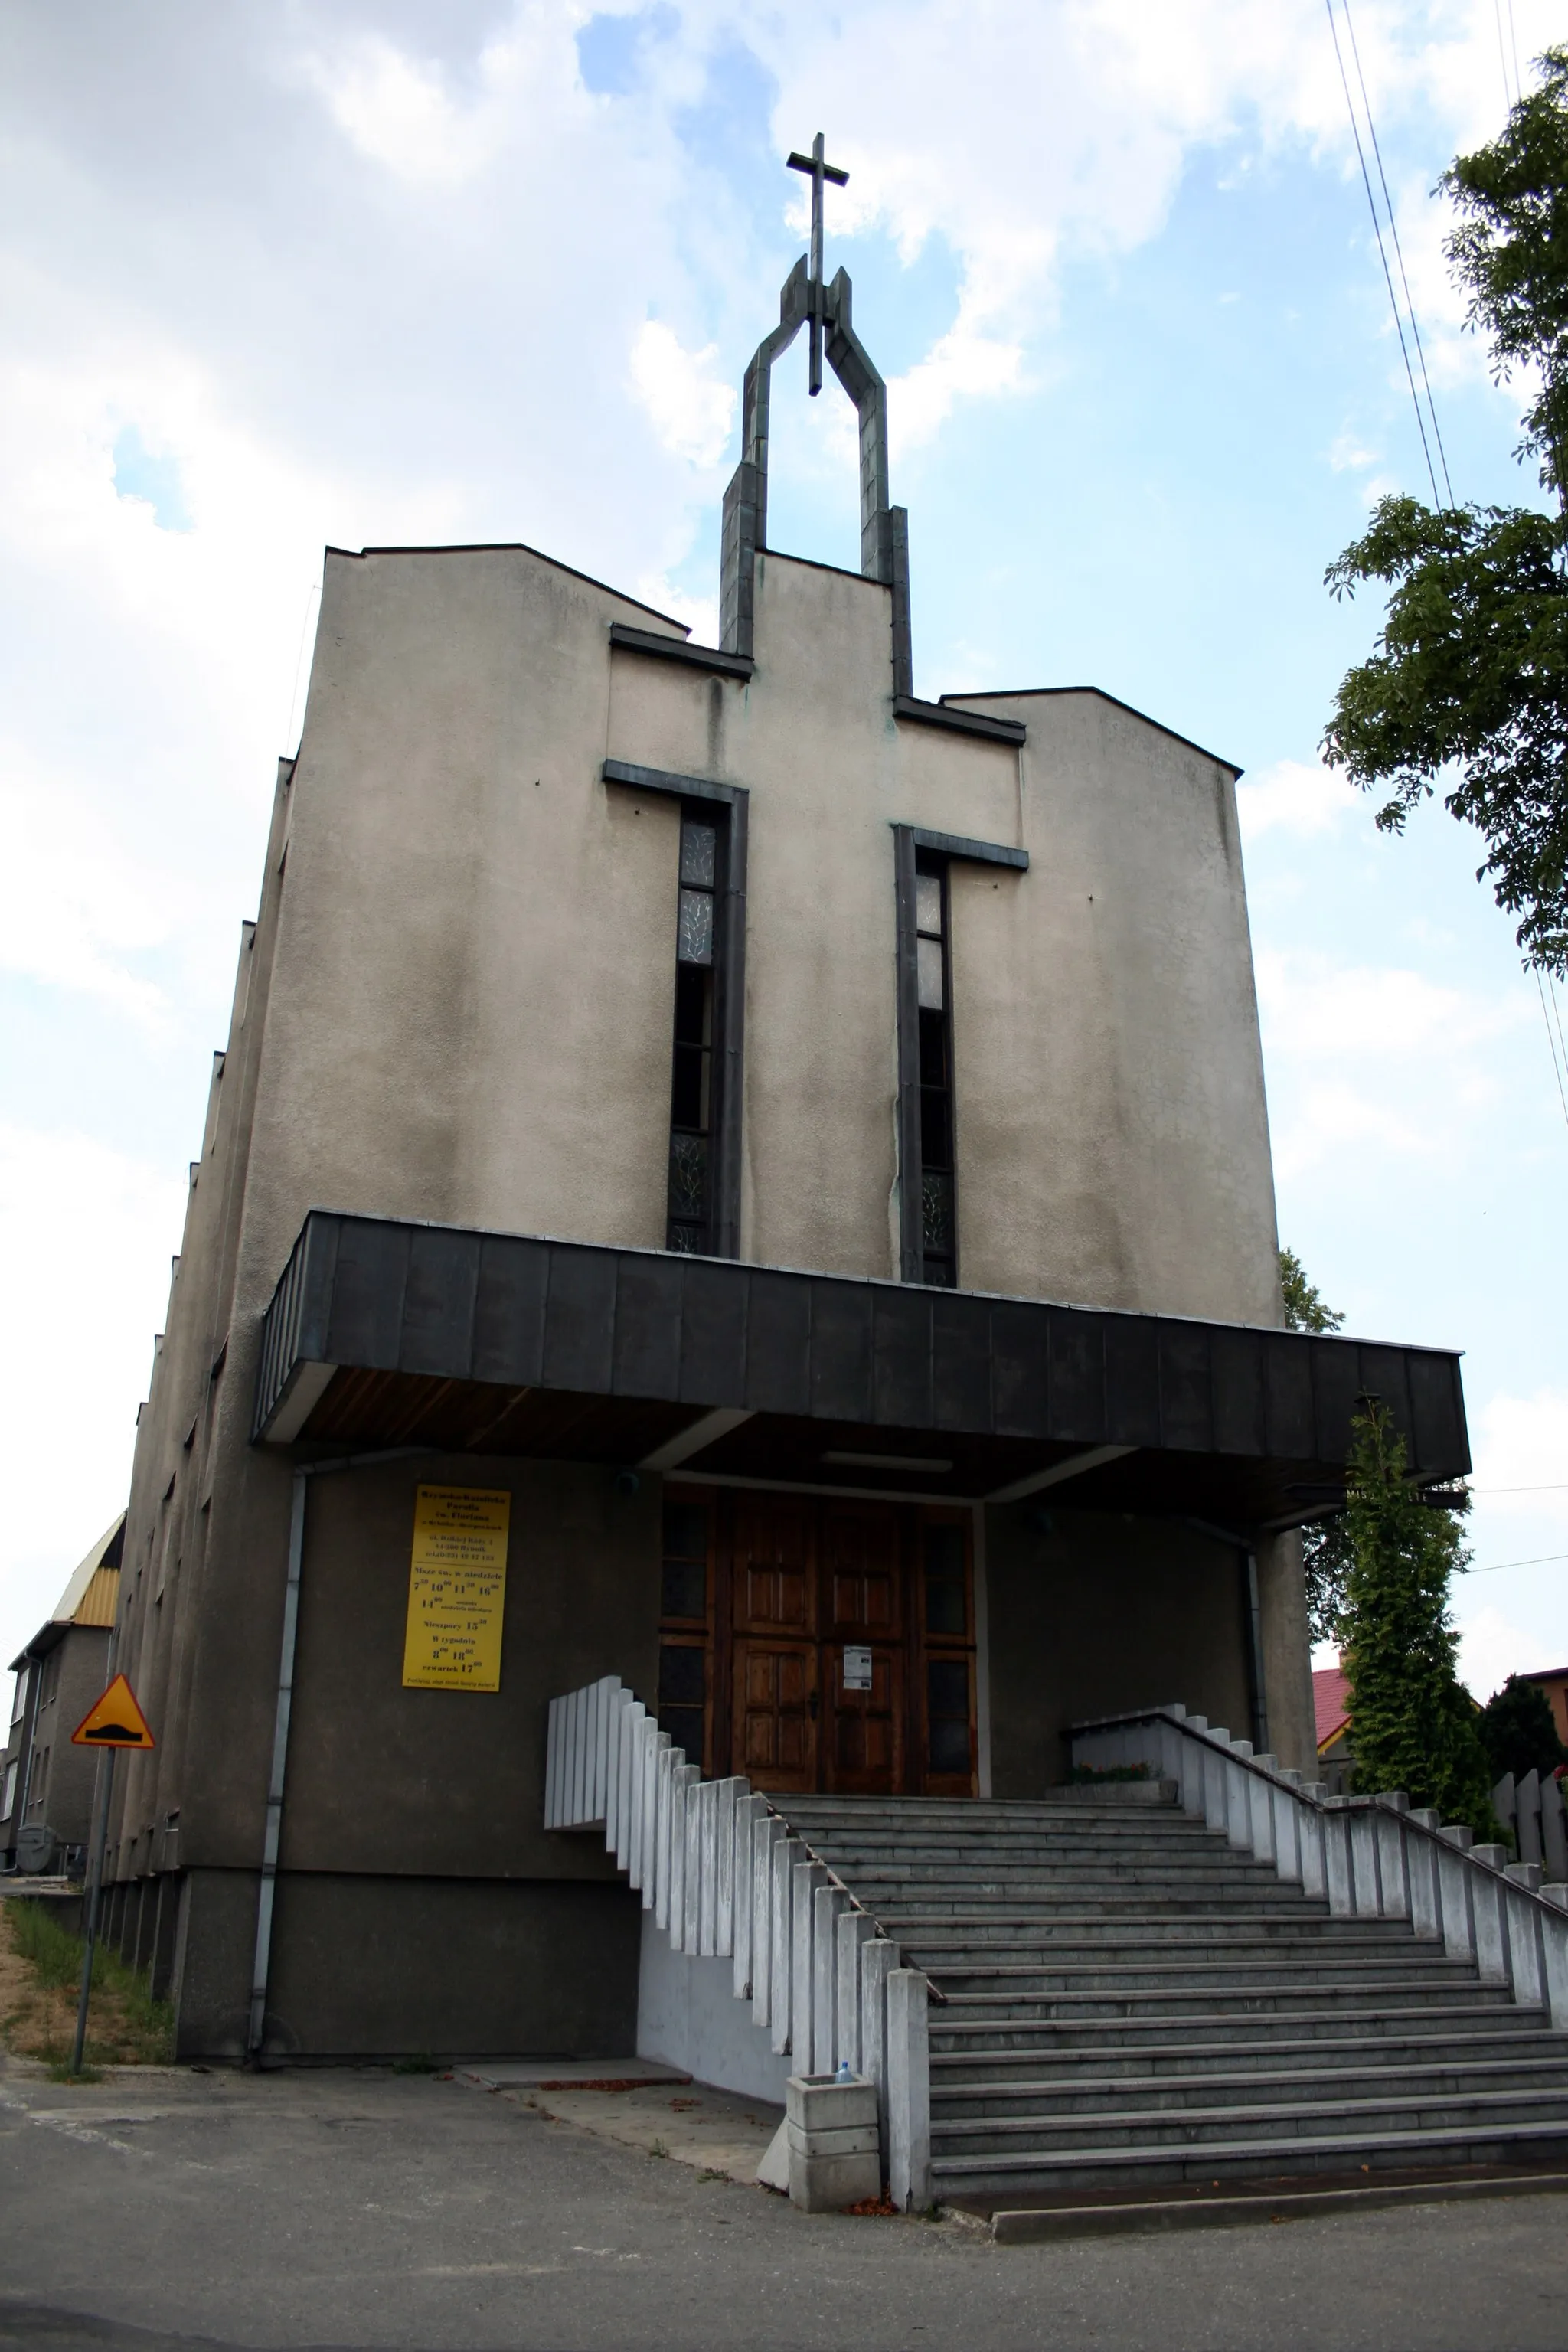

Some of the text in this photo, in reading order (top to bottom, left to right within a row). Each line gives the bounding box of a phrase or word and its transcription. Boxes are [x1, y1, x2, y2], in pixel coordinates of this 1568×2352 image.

[452, 1512, 489, 1521] Floriana
[423, 1621, 462, 1631] Nieszpory
[441, 1637, 475, 1645] tygodniu
